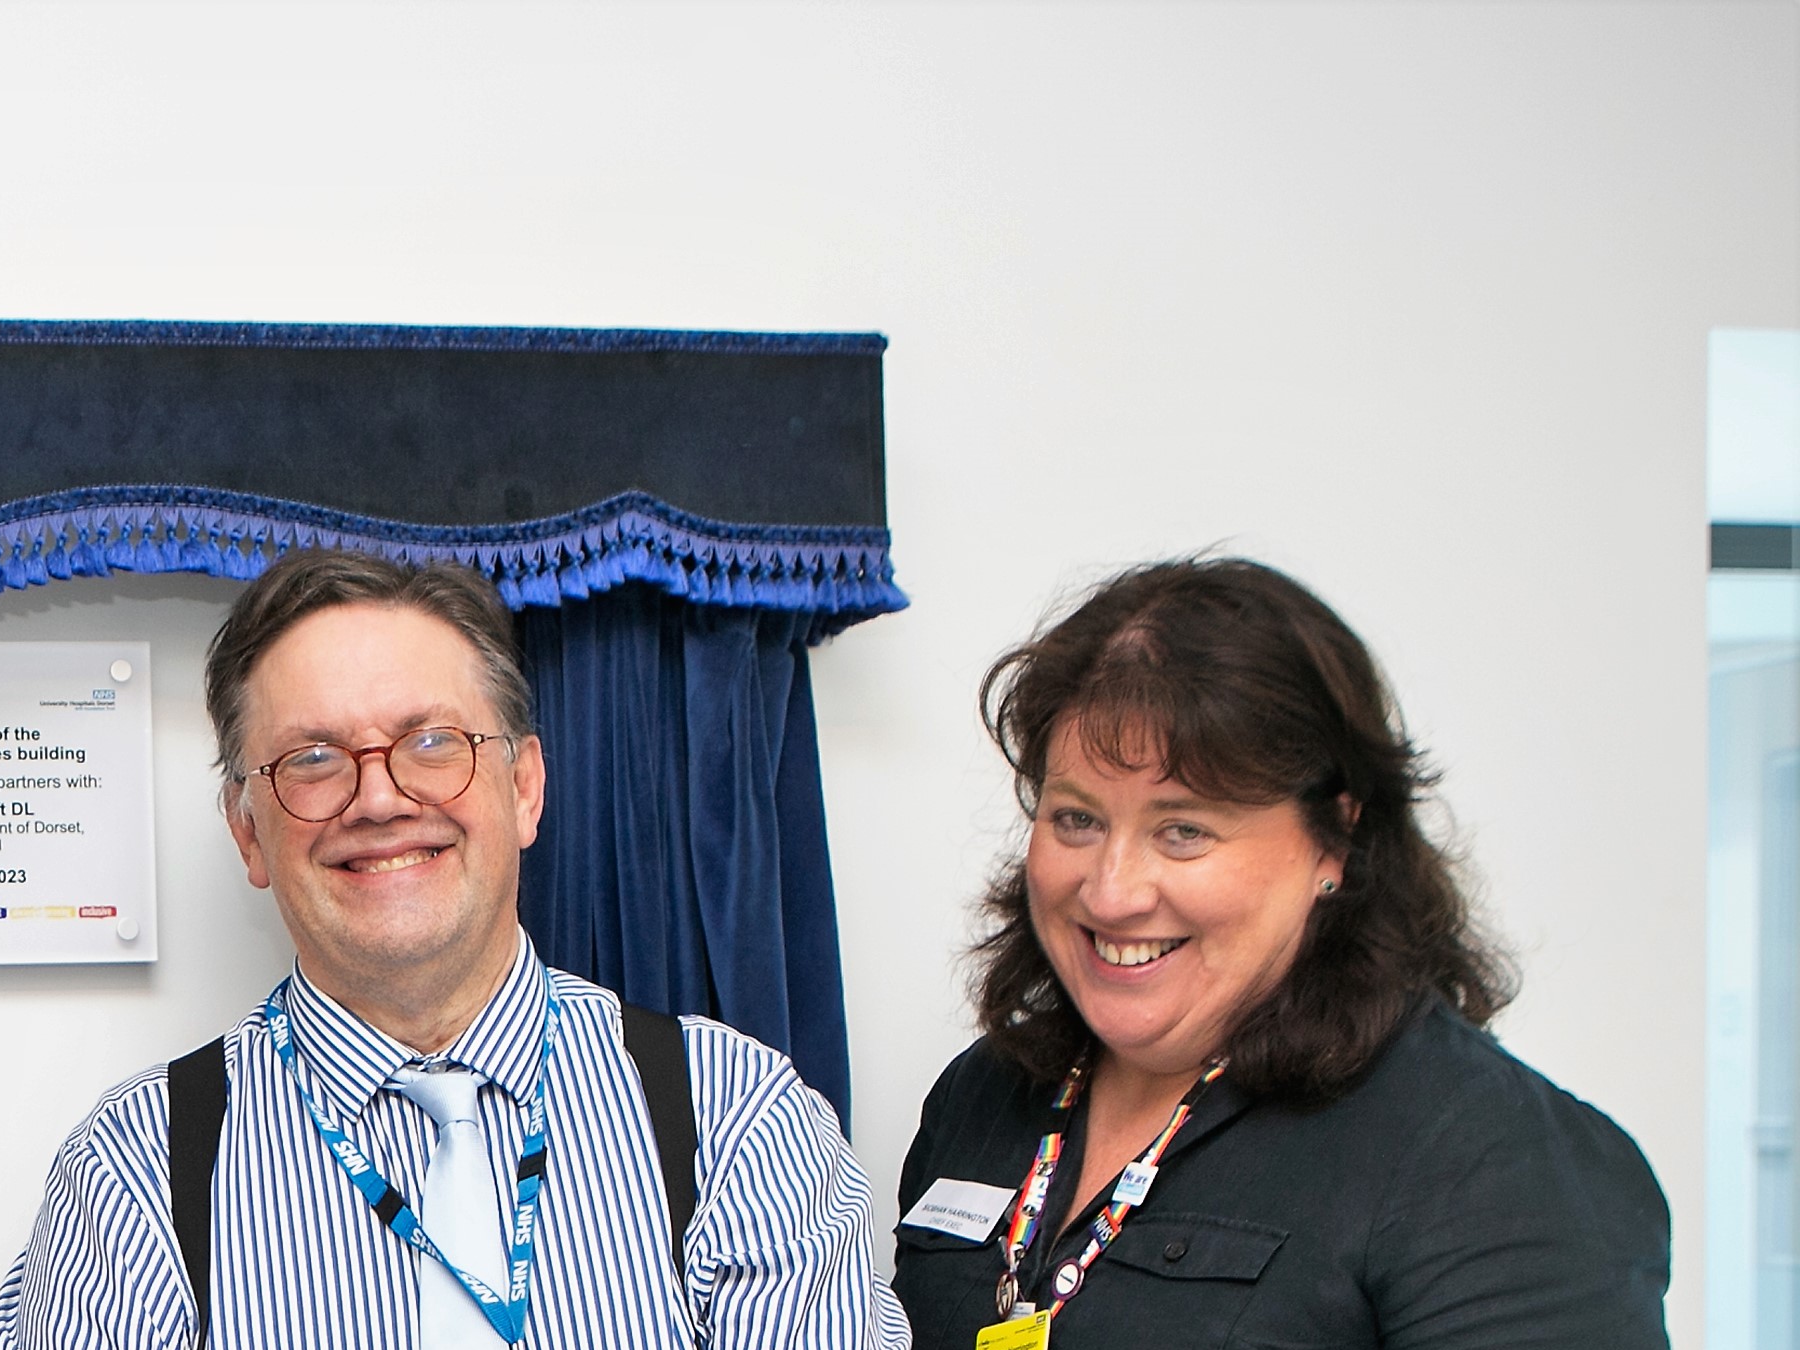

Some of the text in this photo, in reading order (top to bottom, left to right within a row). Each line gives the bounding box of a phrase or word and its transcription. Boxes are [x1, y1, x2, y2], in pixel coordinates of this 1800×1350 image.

[14, 727, 41, 741] the
[17, 746, 86, 764] building
[66, 774, 103, 789] with:
[11, 802, 35, 816] DL
[16, 821, 30, 834] of
[34, 820, 85, 835] Dorset,
[270, 1013, 289, 1051] NHS
[332, 1140, 370, 1176] NHS
[515, 1203, 534, 1247] NHS
[948, 1207, 991, 1225] HARRINGTON
[1094, 1214, 1114, 1242] NHS
[510, 1259, 529, 1302] NHS
